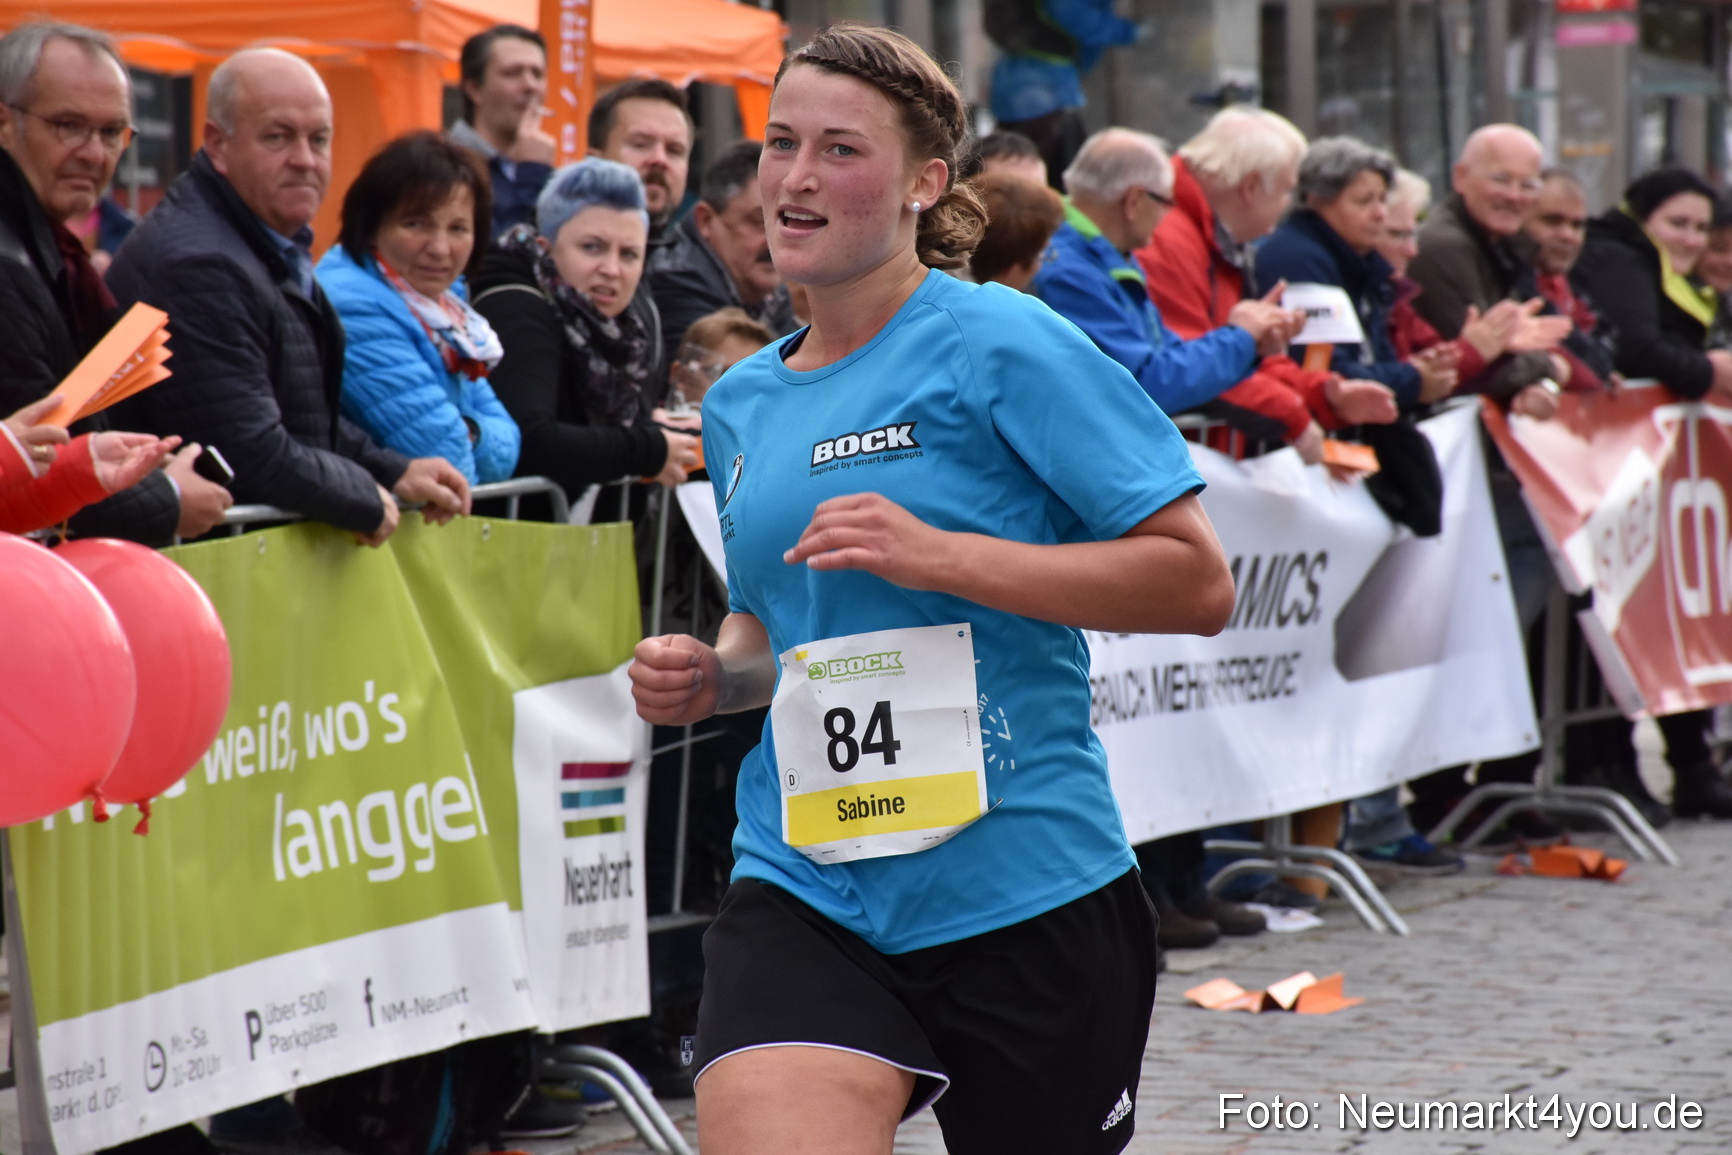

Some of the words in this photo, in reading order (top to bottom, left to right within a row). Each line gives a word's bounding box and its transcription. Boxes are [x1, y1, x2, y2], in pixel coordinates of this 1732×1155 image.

[811, 421, 921, 468] BOCK
[809, 462, 839, 478] inspired
[841, 460, 852, 470] by
[853, 455, 881, 467] smart
[883, 450, 924, 462] concepts
[827, 650, 905, 678] BOCK
[829, 676, 852, 685] inspired
[860, 672, 877, 680] smart
[877, 669, 906, 678] concepts
[203, 700, 298, 785] weiß,
[303, 679, 407, 760] wo's
[823, 700, 902, 773] 84
[788, 774, 796, 786] D
[837, 793, 907, 822] Sabine
[298, 989, 328, 1018] 500
[244, 1009, 264, 1062] P
[1101, 1101, 1133, 1131] adidas
